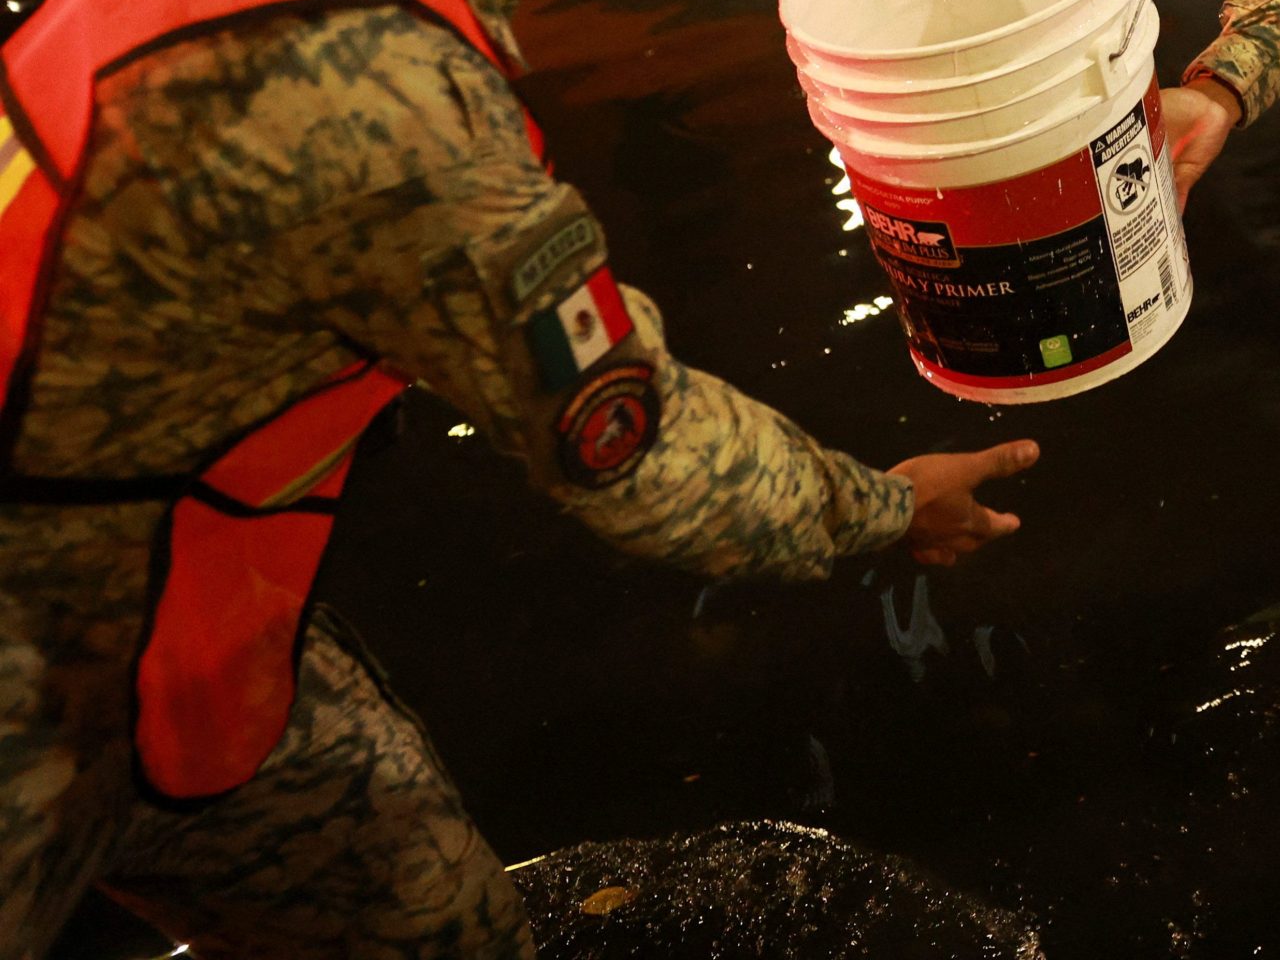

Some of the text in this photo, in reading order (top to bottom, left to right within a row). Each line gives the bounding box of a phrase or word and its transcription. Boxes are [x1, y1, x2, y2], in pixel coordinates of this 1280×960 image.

[1101, 120, 1143, 162] ADVERTENCIA
[1105, 112, 1136, 145] WARNING
[865, 205, 920, 244] BEHR
[934, 281, 1016, 298] PRIMER
[1127, 298, 1153, 324] BEHR
